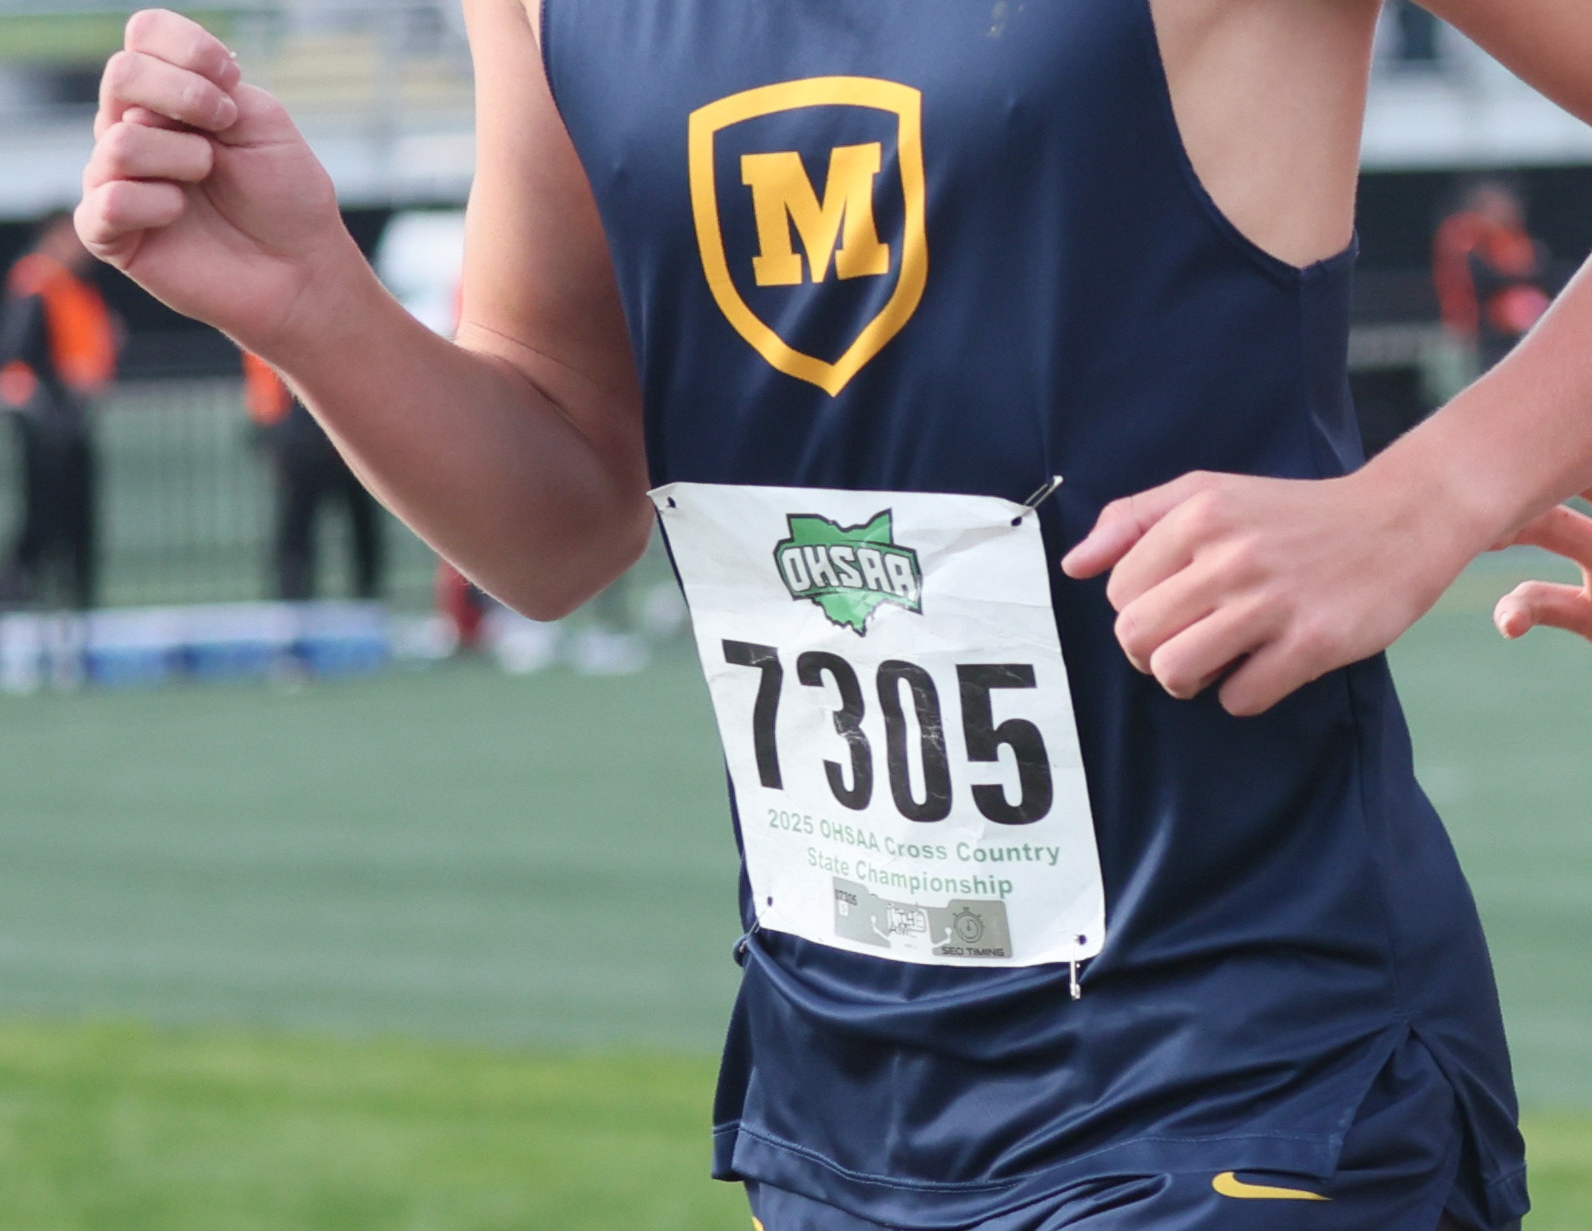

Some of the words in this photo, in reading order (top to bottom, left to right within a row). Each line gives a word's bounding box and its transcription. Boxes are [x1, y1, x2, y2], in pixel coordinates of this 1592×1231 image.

[741, 142, 889, 286] M
[781, 545, 918, 602] OHSAA
[722, 639, 1053, 825] 7305
[768, 808, 814, 835] 2025
[820, 819, 880, 852] OHSAA
[885, 836, 948, 860] Cross
[956, 841, 1060, 866] Country
[807, 847, 850, 876] State
[855, 859, 1013, 899] Championship
[941, 946, 964, 955] SEO
[967, 947, 1005, 957] TIMING
